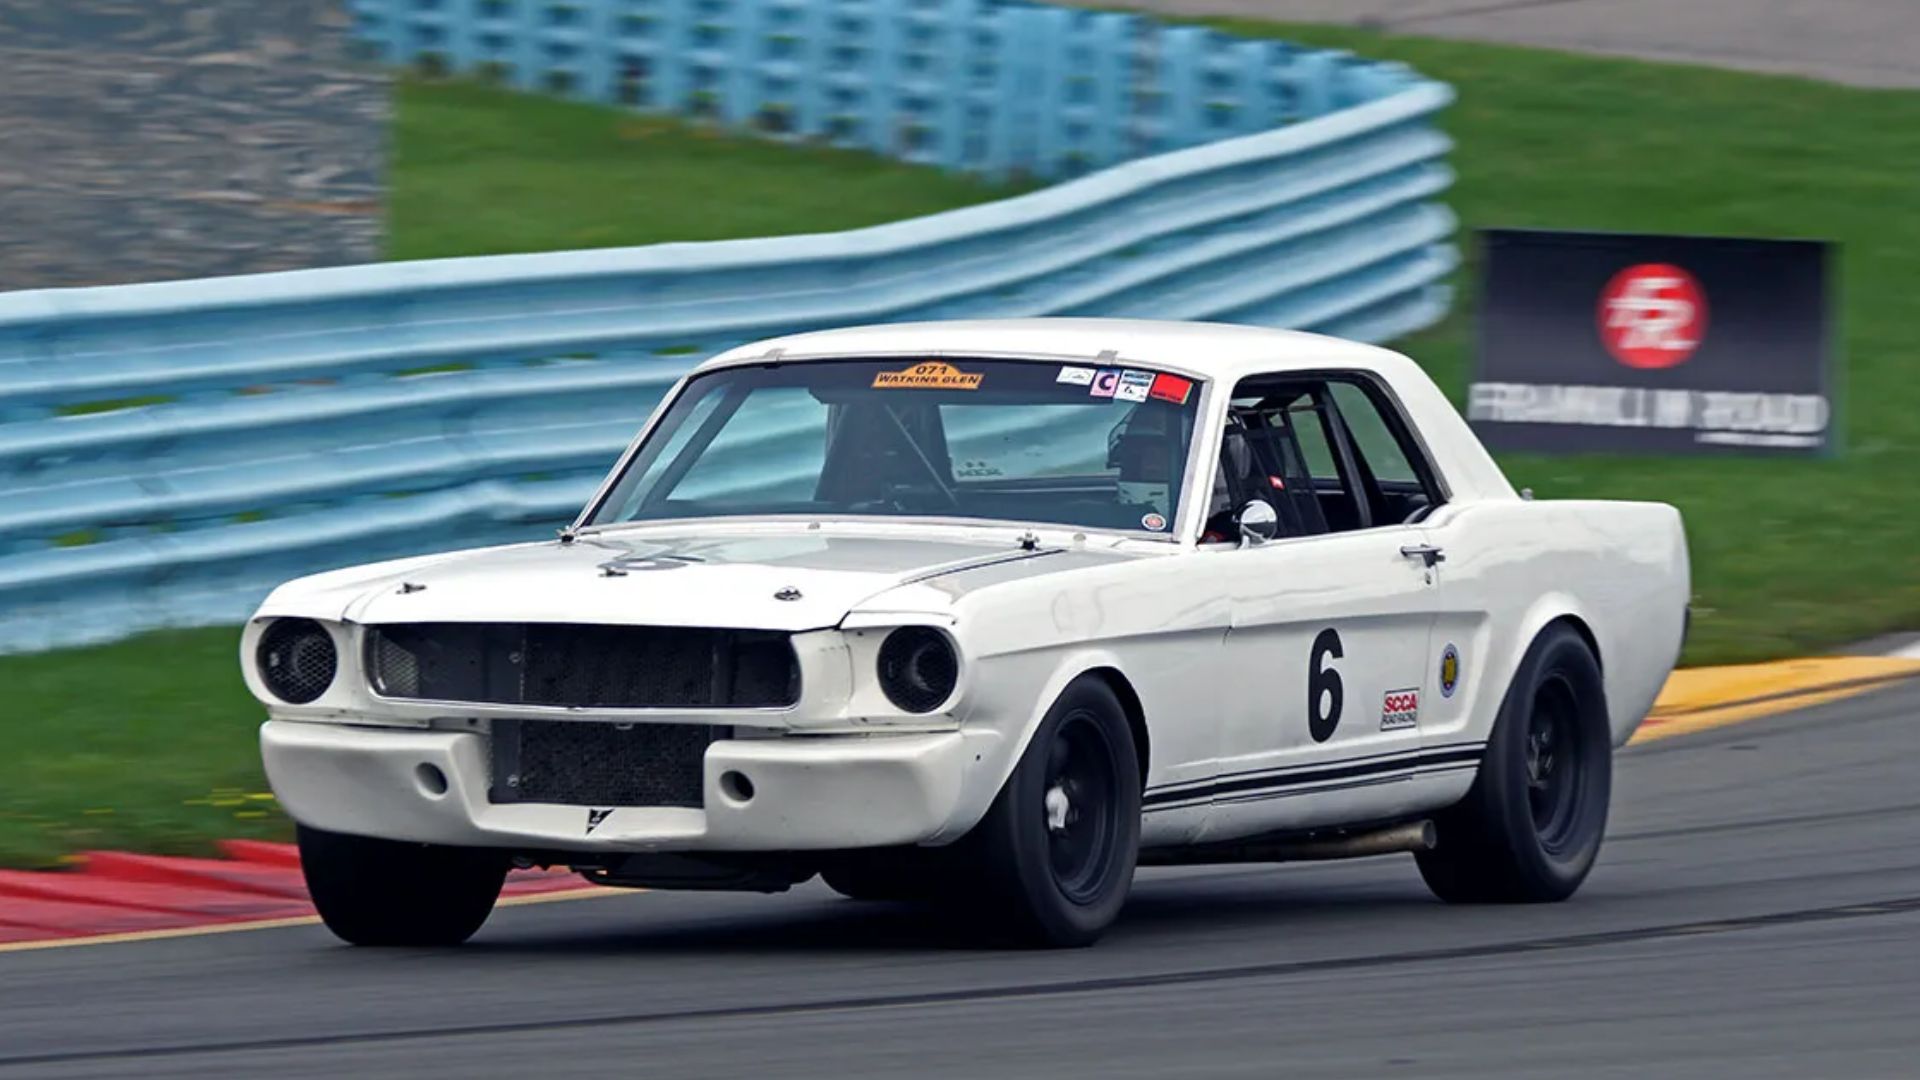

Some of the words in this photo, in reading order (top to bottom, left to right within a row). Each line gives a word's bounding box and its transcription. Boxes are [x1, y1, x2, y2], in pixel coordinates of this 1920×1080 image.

[878, 374, 938, 384] WATKINS
[942, 375, 980, 384] GLEN
[915, 365, 948, 376] 071
[1098, 374, 1115, 391] C
[1308, 627, 1344, 744] 6
[1384, 693, 1417, 714] SCCA
